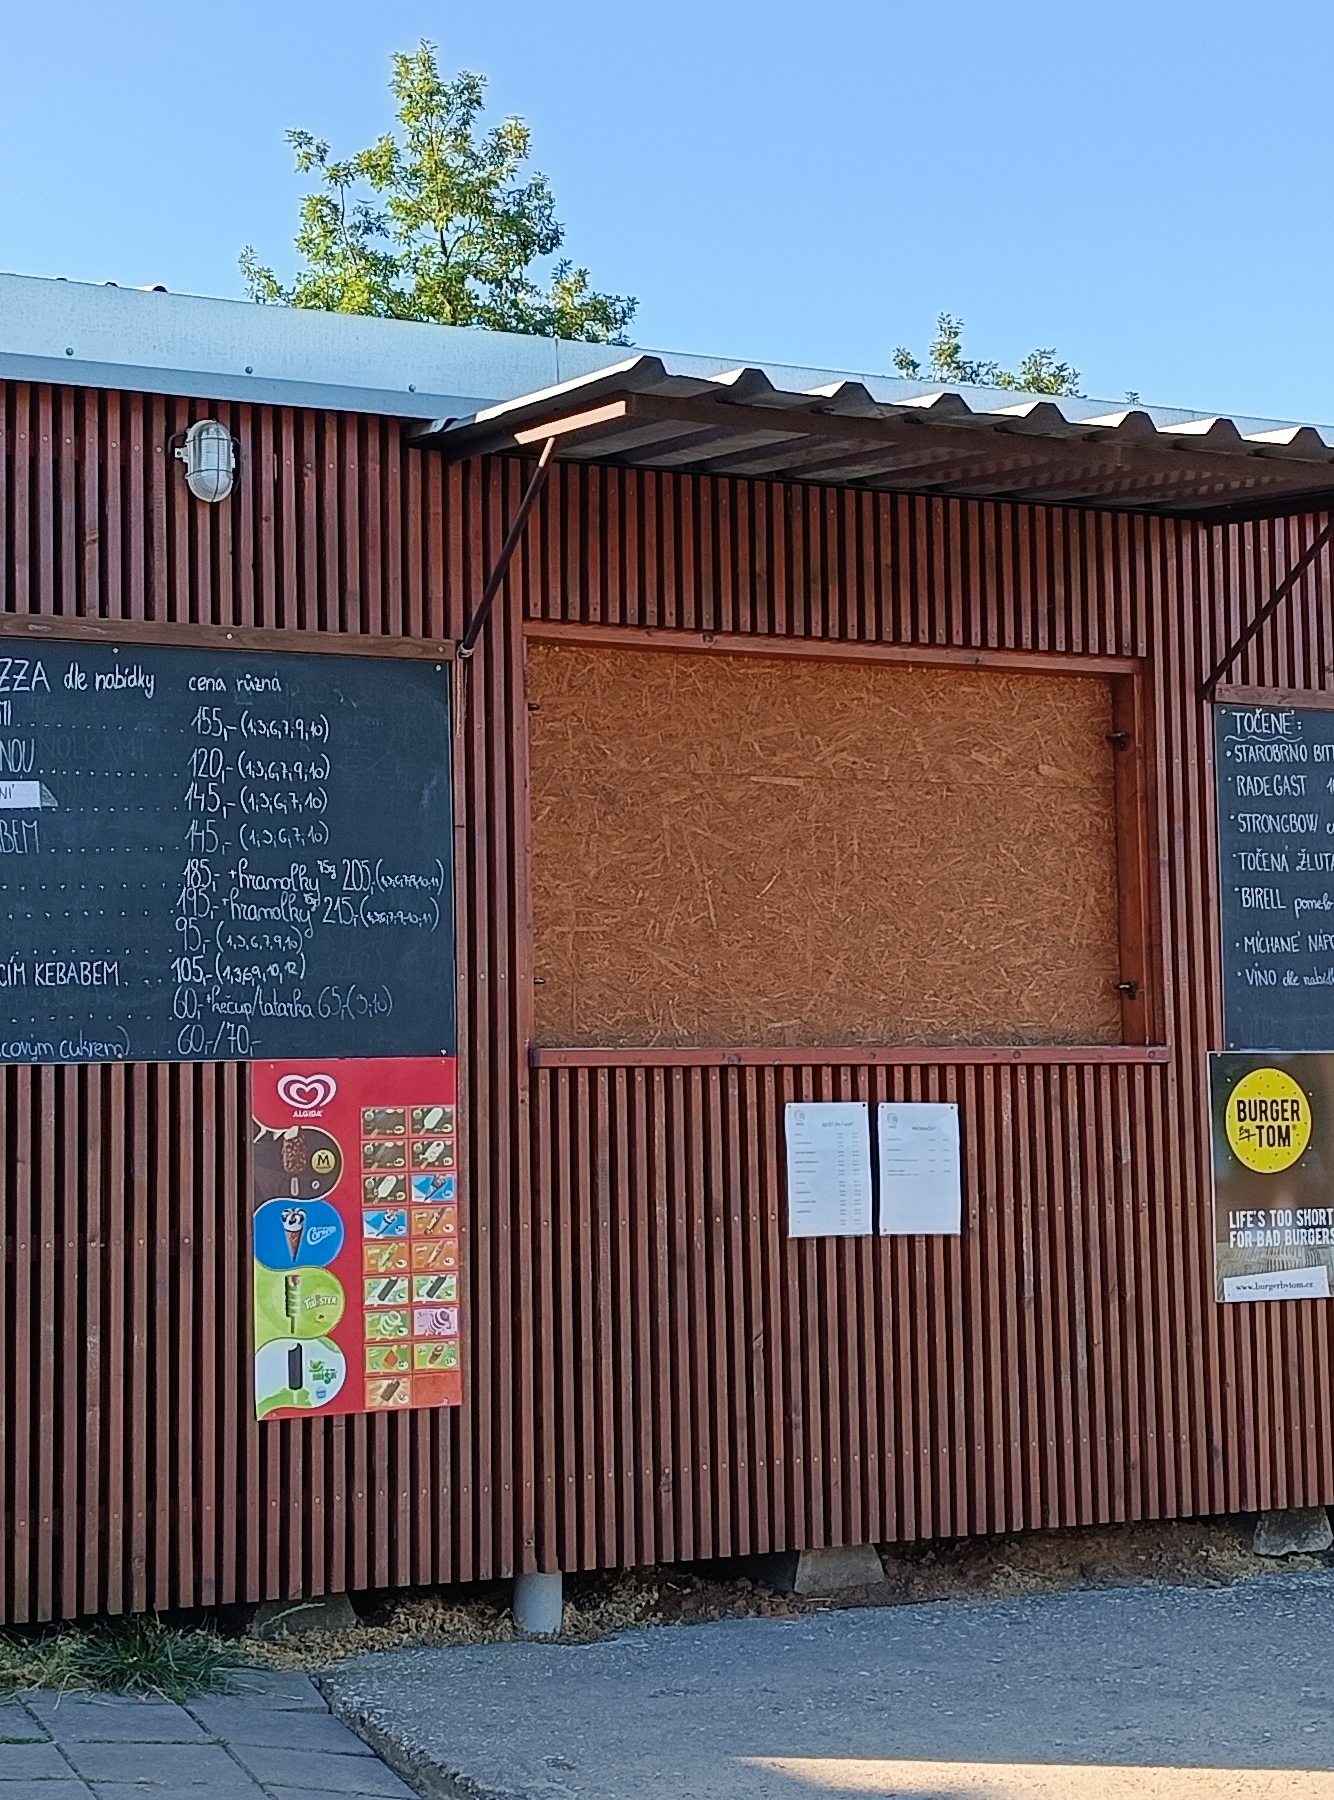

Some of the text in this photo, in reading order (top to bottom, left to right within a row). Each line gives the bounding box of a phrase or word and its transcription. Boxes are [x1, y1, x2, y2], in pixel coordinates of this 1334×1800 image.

[63, 662, 88, 691] dle
[95, 665, 155, 698] nabídky
[188, 676, 227, 692] cena
[236, 669, 282, 692] různá
[1234, 744, 1308, 763] STAROBRNO
[1237, 814, 1318, 834] STRONGBOW
[1237, 845, 1290, 872] TOČENÁ
[1241, 886, 1287, 909] BIRELL
[1243, 931, 1302, 954] MÍCHANÉ
[34, 961, 119, 988] KEBABEM
[1245, 961, 1277, 986] VÍNO
[1282, 968, 1300, 986] dle
[293, 1109, 323, 1118] ALGIDA
[1236, 1098, 1301, 1122] BURGER
[1255, 1124, 1291, 1148] TOM
[1229, 1207, 1334, 1229] LIFE'S TOO SHORT
[1229, 1230, 1251, 1249] FOR
[1252, 1229, 1282, 1248] BAD
[1235, 1280, 1314, 1292] www.burgerbytom.cz
